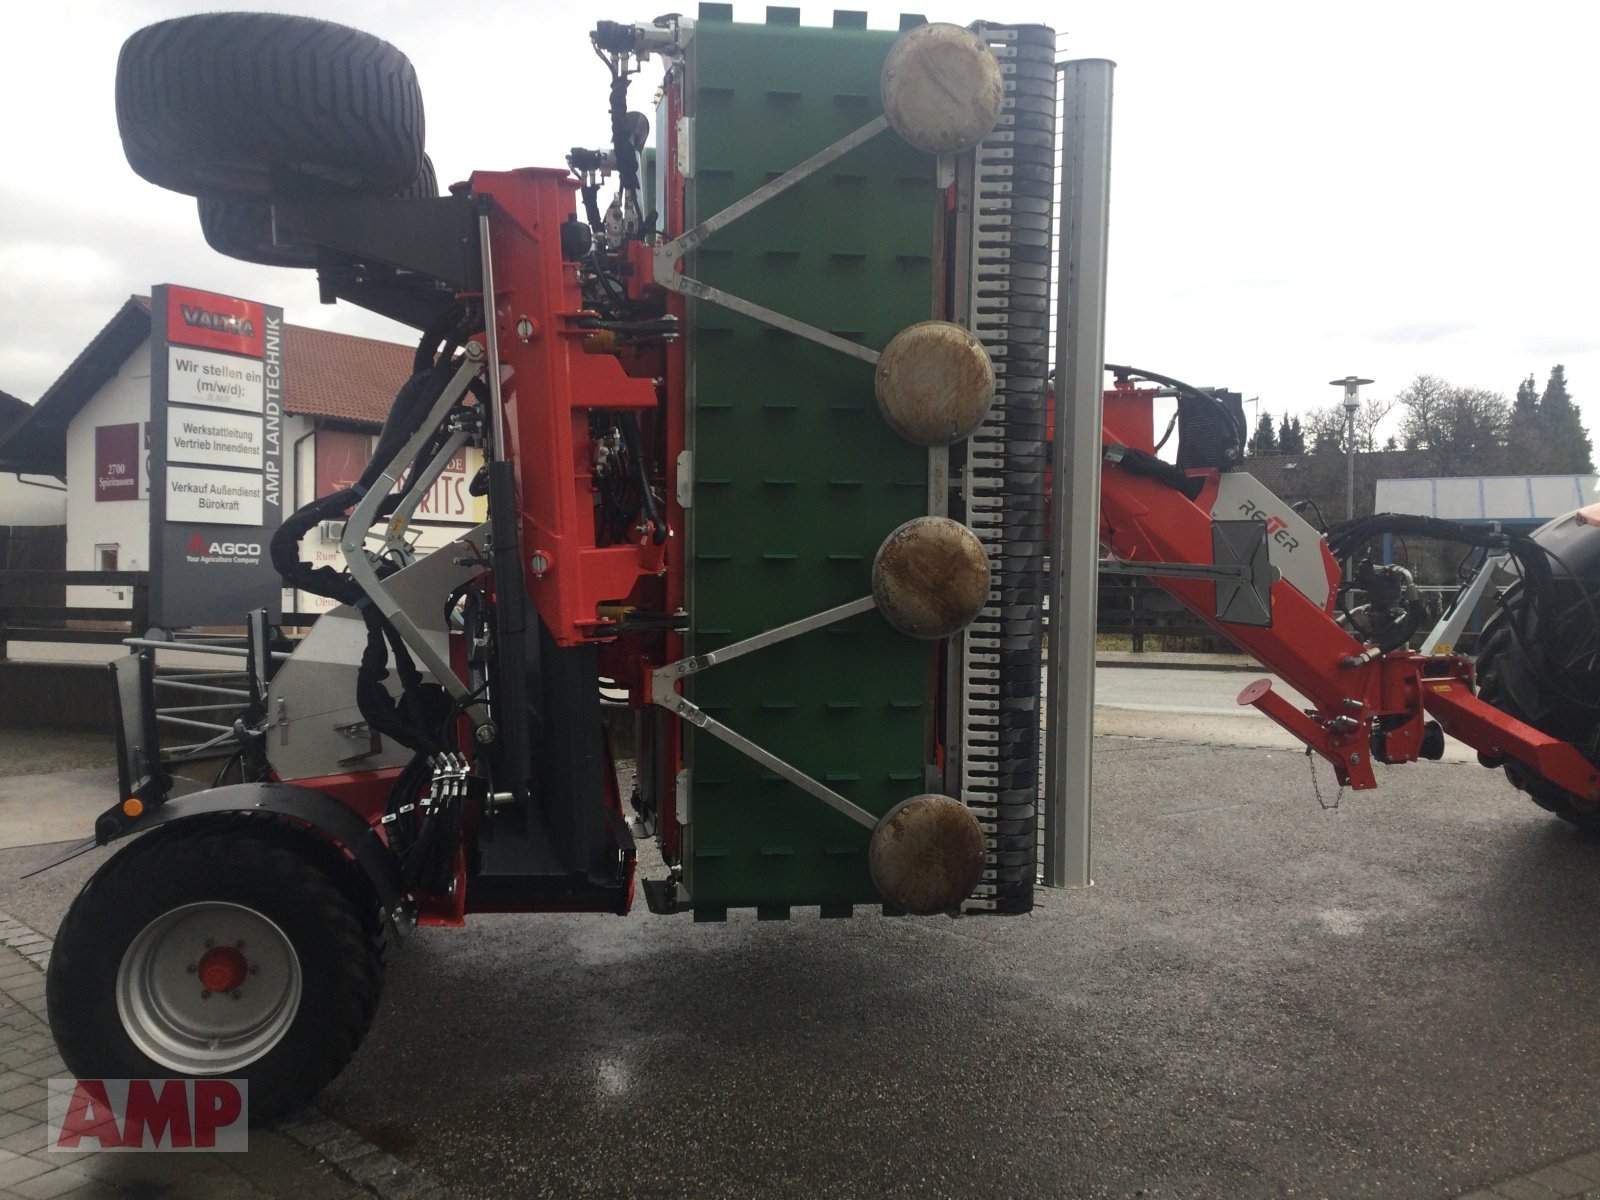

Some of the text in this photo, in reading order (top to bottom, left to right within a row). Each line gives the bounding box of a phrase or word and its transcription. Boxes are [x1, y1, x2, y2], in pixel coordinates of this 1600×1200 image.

[181, 303, 255, 338] VALTRA
[175, 358, 262, 384] Wir stellen ein
[196, 378, 246, 399] (m/w/d):
[265, 317, 280, 506] AMP LANDTECHNIK
[183, 422, 253, 442] Werkstattleitung
[174, 437, 260, 456] Vertrieb Innendienst
[107, 463, 126, 475] 2700
[171, 481, 261, 499] Verkauf Außendienst
[198, 498, 240, 511] Bürokraft
[208, 542, 262, 556] AGCO
[186, 555, 260, 566] Your Agriculture Company
